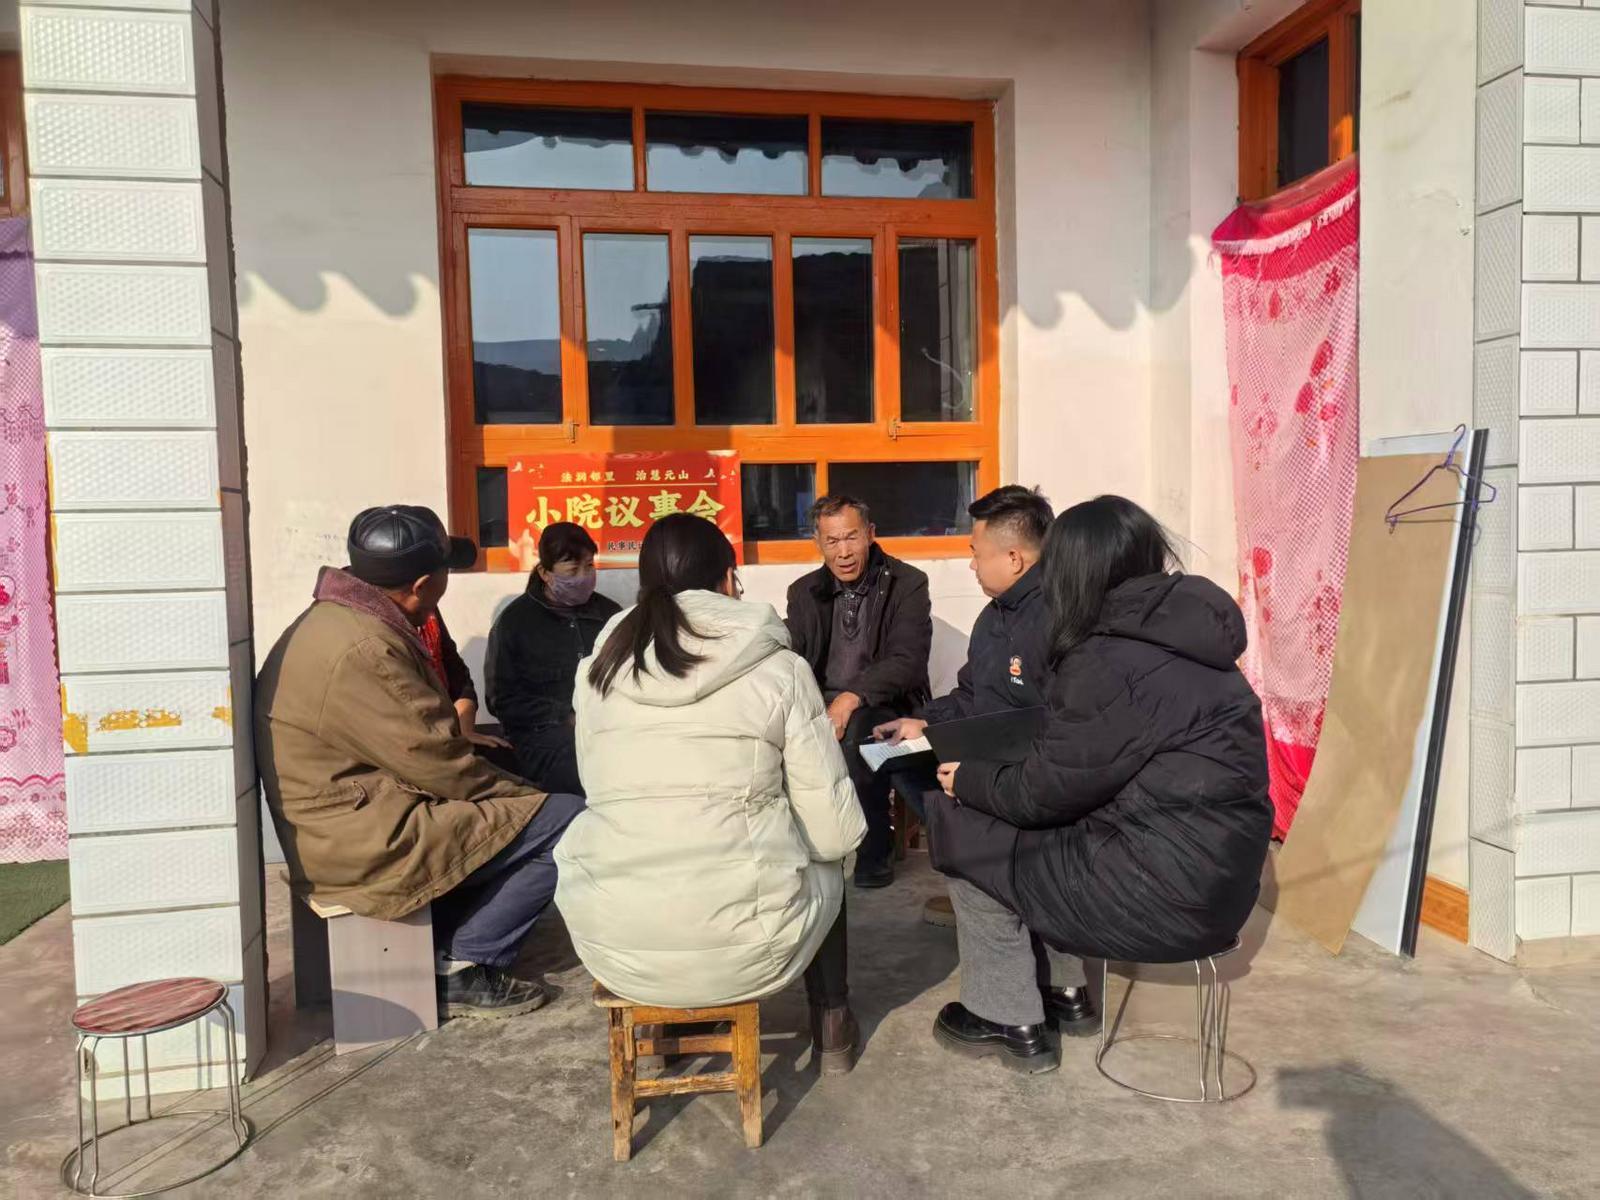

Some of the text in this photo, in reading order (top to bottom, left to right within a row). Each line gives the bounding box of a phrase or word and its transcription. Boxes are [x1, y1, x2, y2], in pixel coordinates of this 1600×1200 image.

[526, 489, 725, 530] 小院议事会
